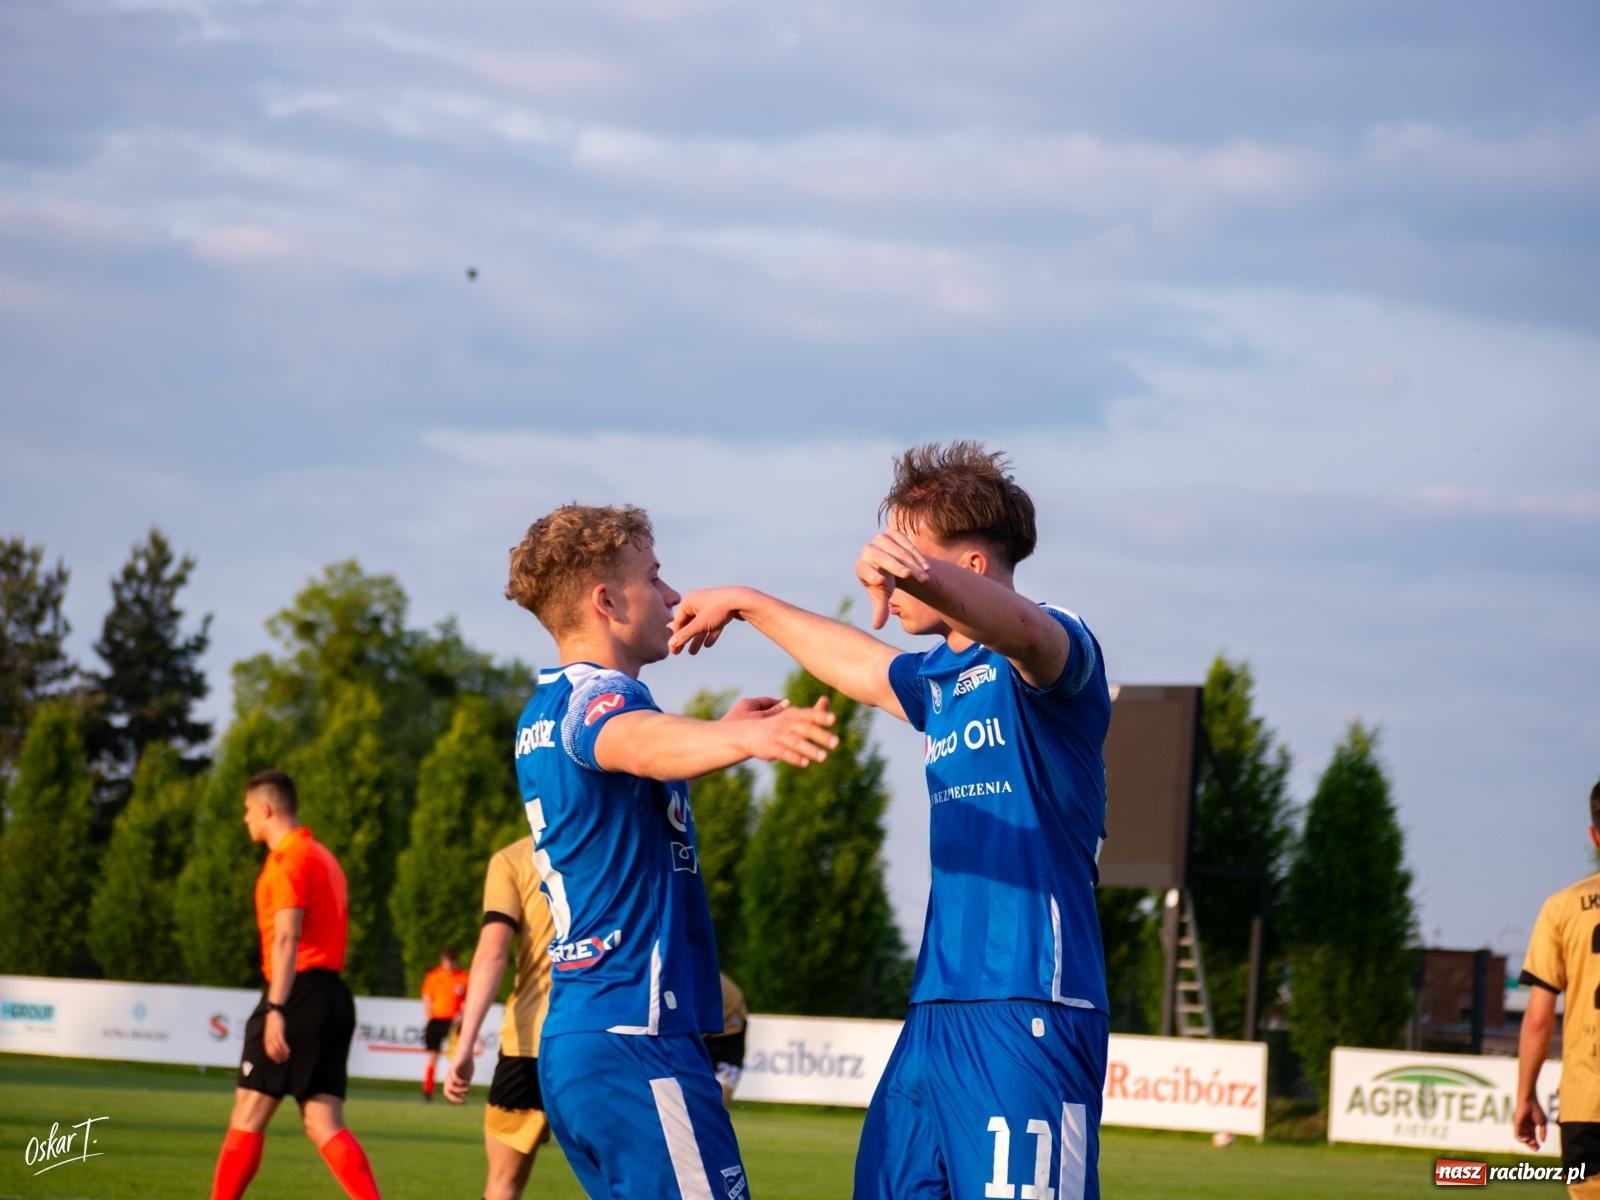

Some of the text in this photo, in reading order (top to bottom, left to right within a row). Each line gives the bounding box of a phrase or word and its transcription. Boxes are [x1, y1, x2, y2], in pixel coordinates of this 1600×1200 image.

[963, 717, 1006, 750] Oil
[743, 1039, 866, 1080] acibórz
[1105, 1060, 1258, 1109] Racibórz
[985, 1116, 1055, 1199] 11
